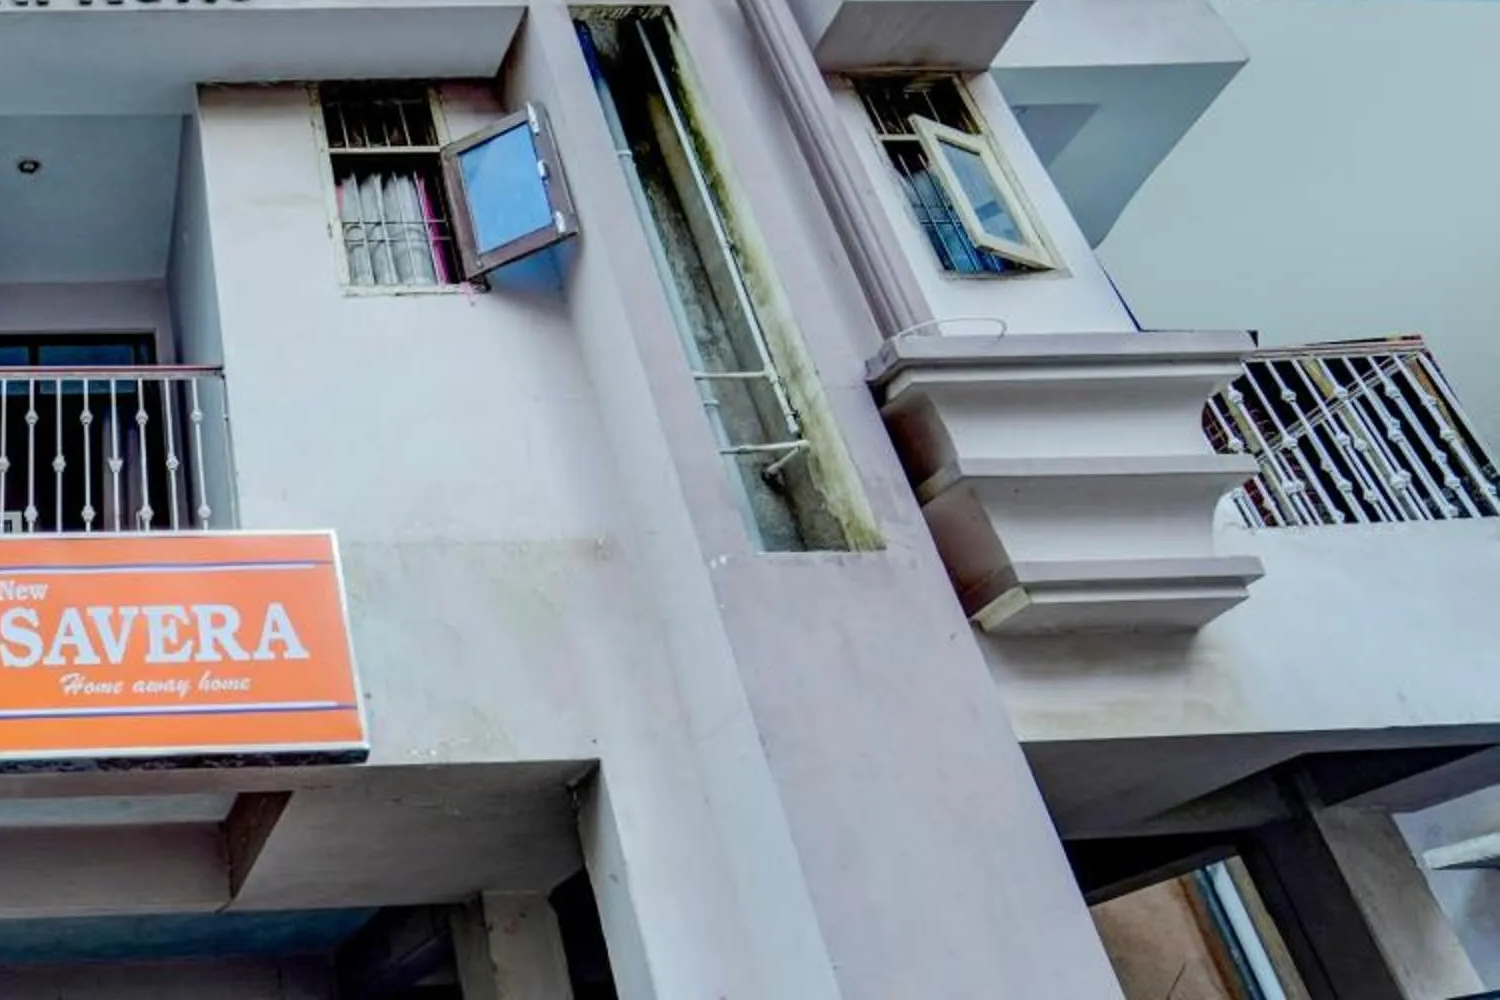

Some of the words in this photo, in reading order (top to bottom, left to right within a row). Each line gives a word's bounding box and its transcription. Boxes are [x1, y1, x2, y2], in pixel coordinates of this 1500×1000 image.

[58, 671, 124, 696] Home
[132, 677, 189, 698] away
[197, 669, 251, 693] home
